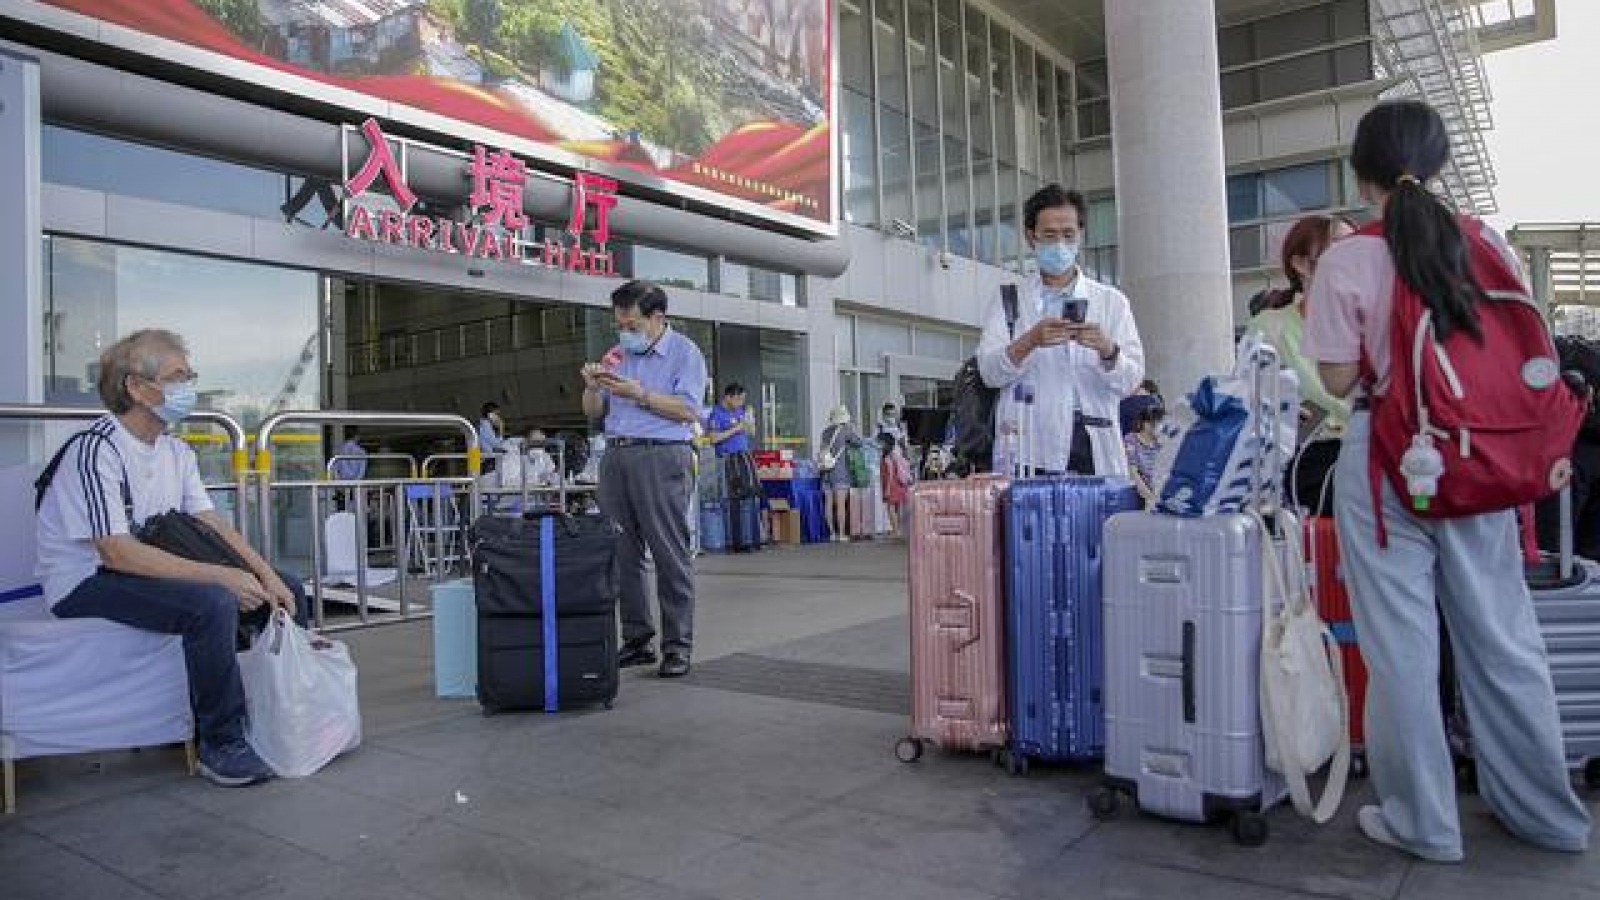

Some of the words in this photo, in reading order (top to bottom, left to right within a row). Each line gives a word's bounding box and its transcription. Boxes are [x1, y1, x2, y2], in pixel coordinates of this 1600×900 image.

[344, 117, 620, 244] 入境厅
[346, 204, 521, 261] ARRIVAL
[545, 238, 621, 276] HALL
